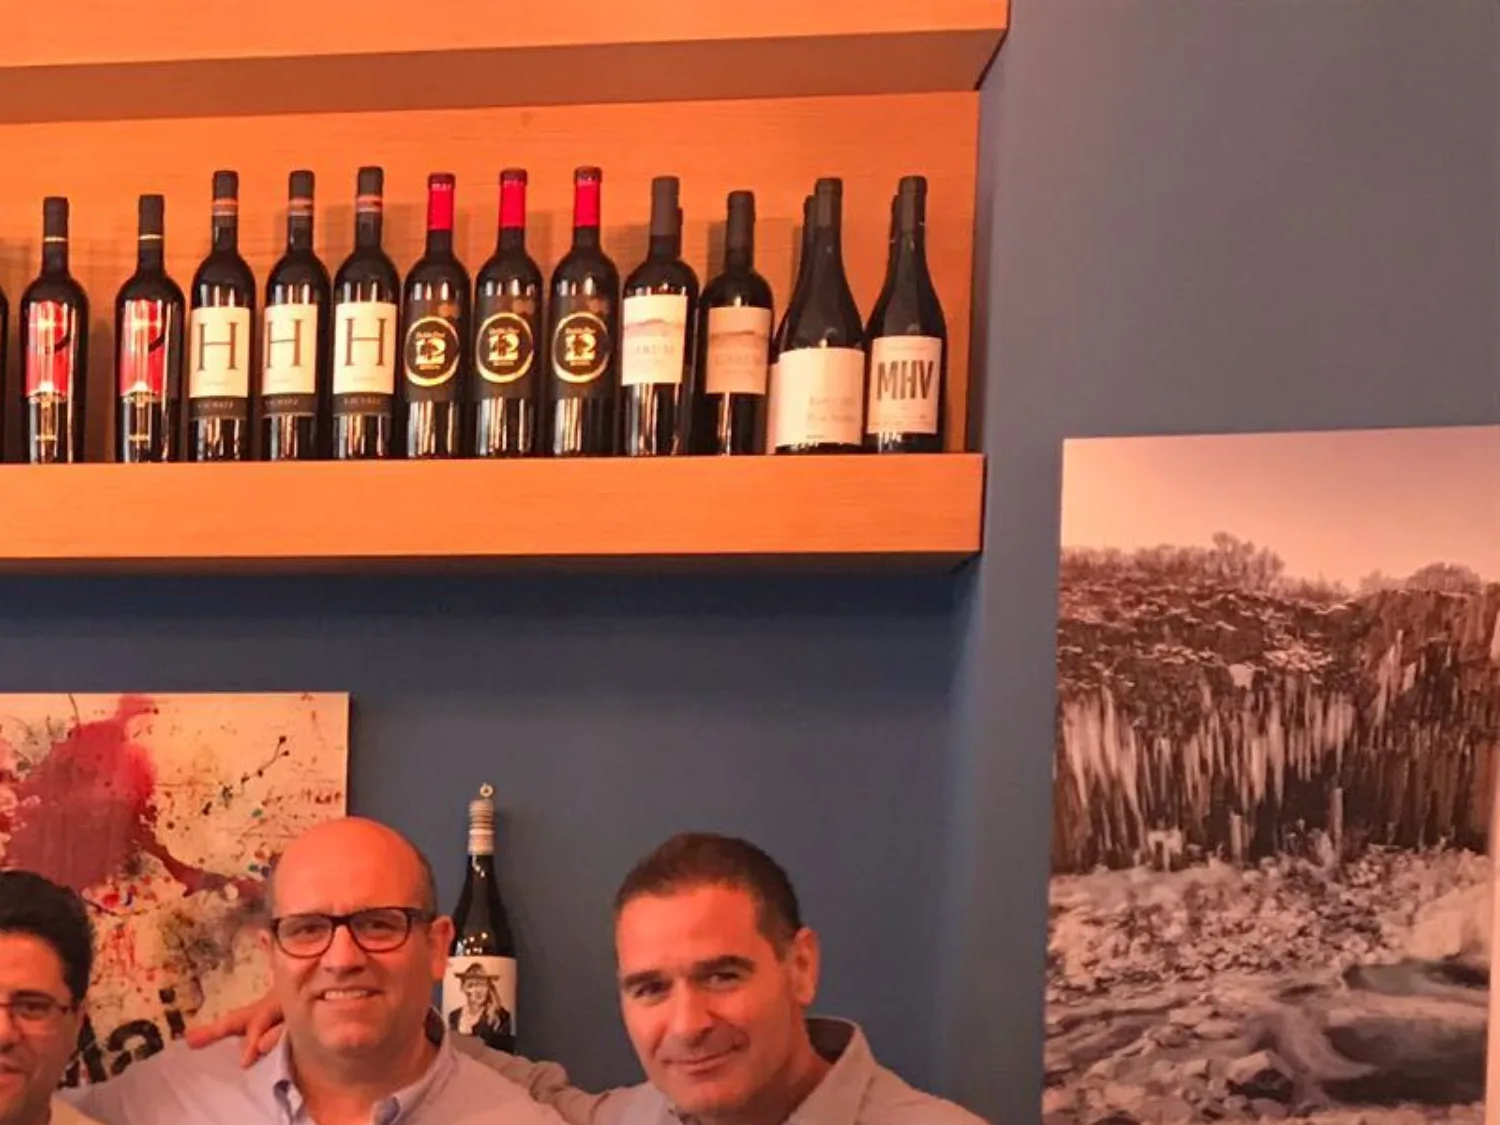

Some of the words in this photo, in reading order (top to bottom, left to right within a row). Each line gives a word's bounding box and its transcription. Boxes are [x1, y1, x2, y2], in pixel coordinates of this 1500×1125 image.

[197, 322, 238, 371] H
[265, 319, 303, 369] H
[344, 317, 387, 366] H
[876, 360, 934, 401] MHV
